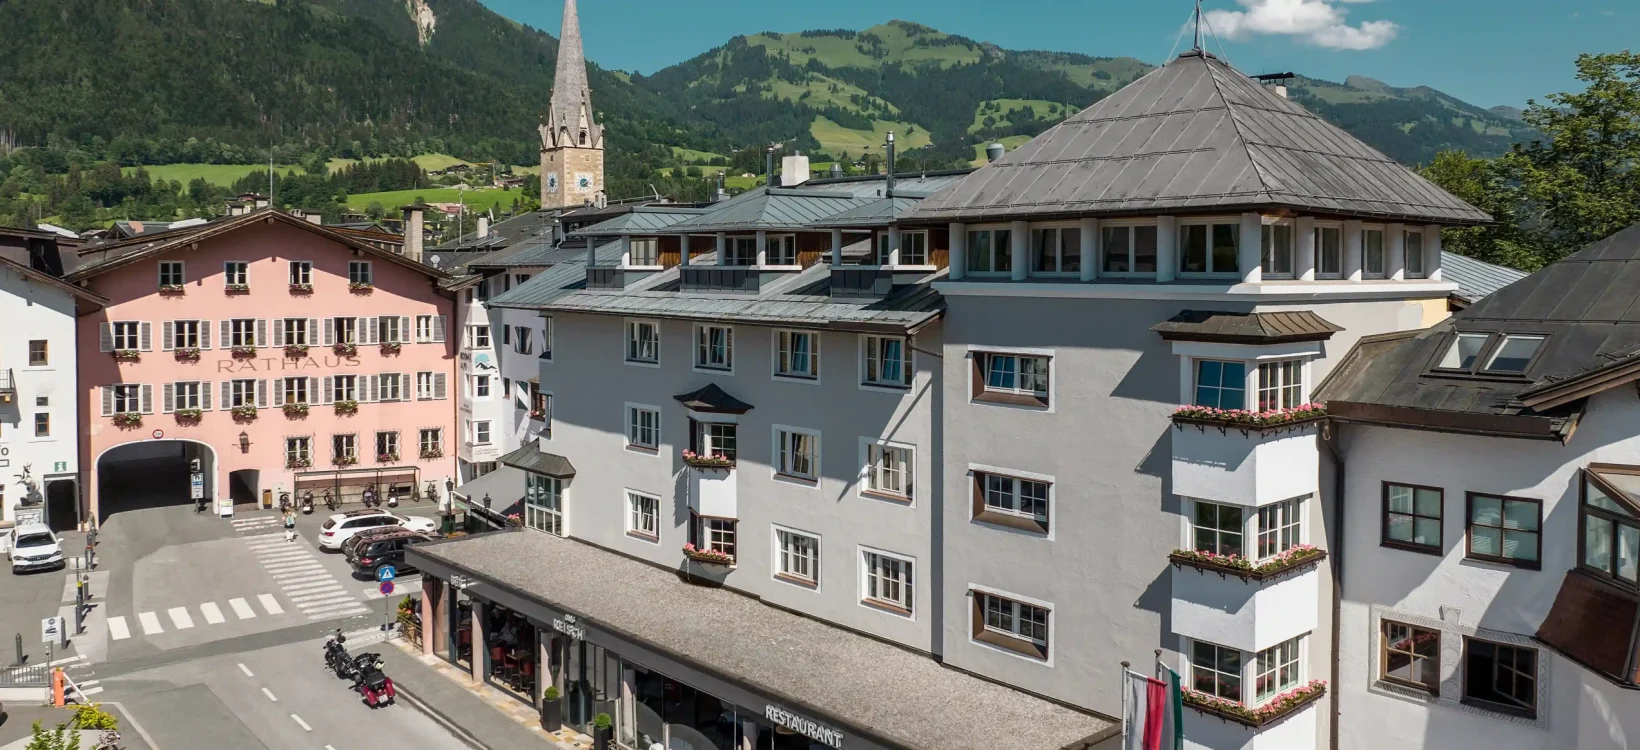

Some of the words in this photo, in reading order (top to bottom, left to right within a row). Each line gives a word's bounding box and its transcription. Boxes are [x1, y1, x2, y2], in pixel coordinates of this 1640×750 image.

[217, 355, 361, 373] RATHAUS
[553, 618, 584, 641] REISCH
[765, 704, 843, 748] RESTAURANT
